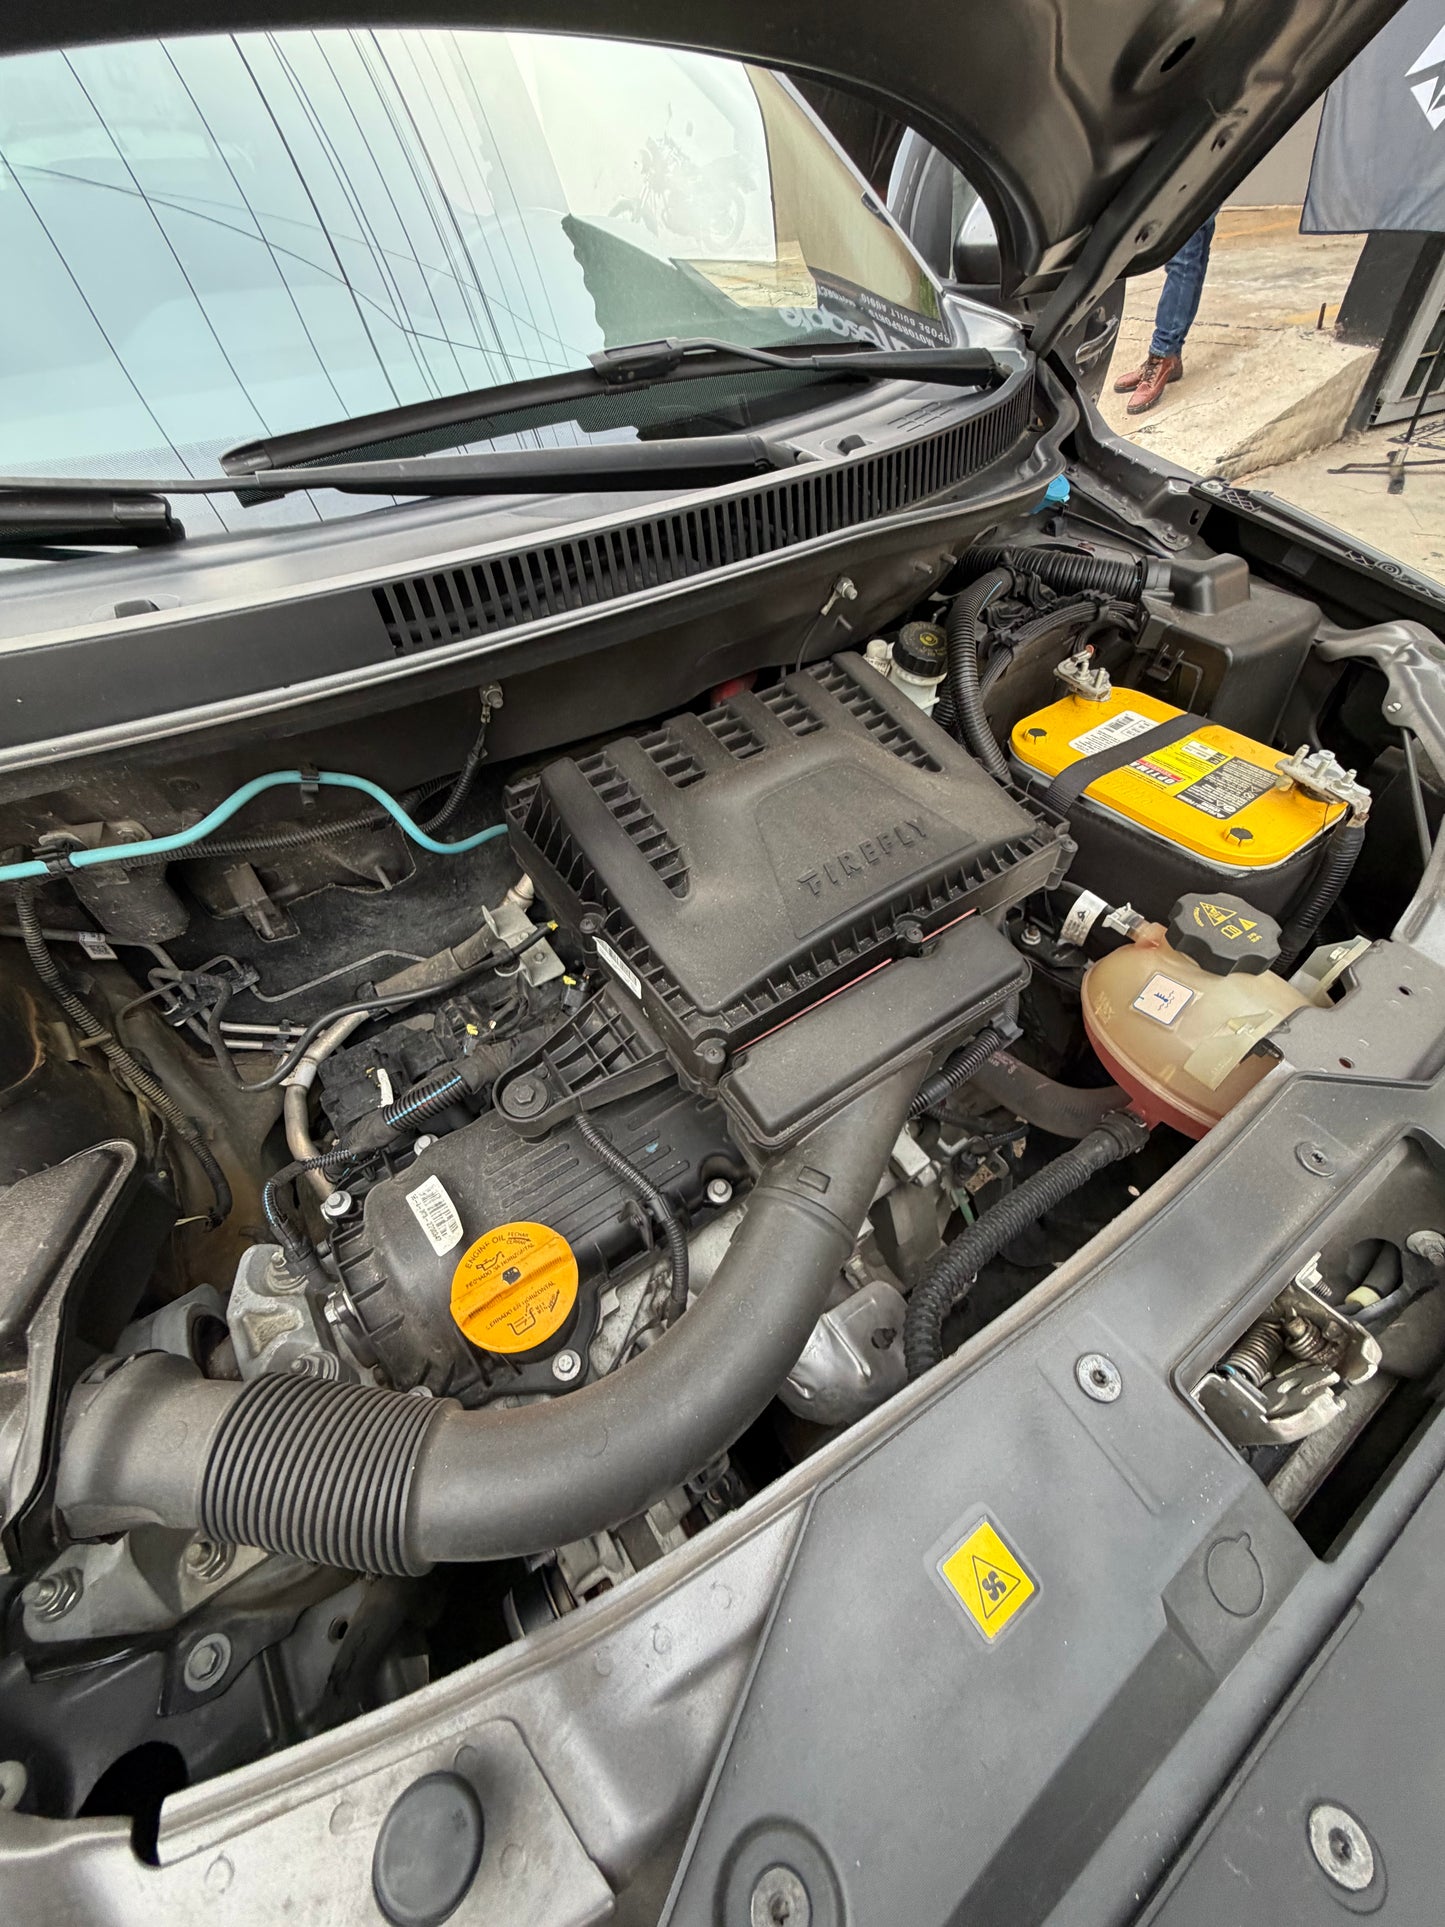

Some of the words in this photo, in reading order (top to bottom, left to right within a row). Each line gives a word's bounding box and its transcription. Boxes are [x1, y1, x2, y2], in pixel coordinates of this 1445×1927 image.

[889, 305, 917, 326] BUILT
[1129, 761, 1176, 785] OPTIMA
[796, 816, 927, 896] FIREFLY
[491, 1234, 506, 1244] OIL
